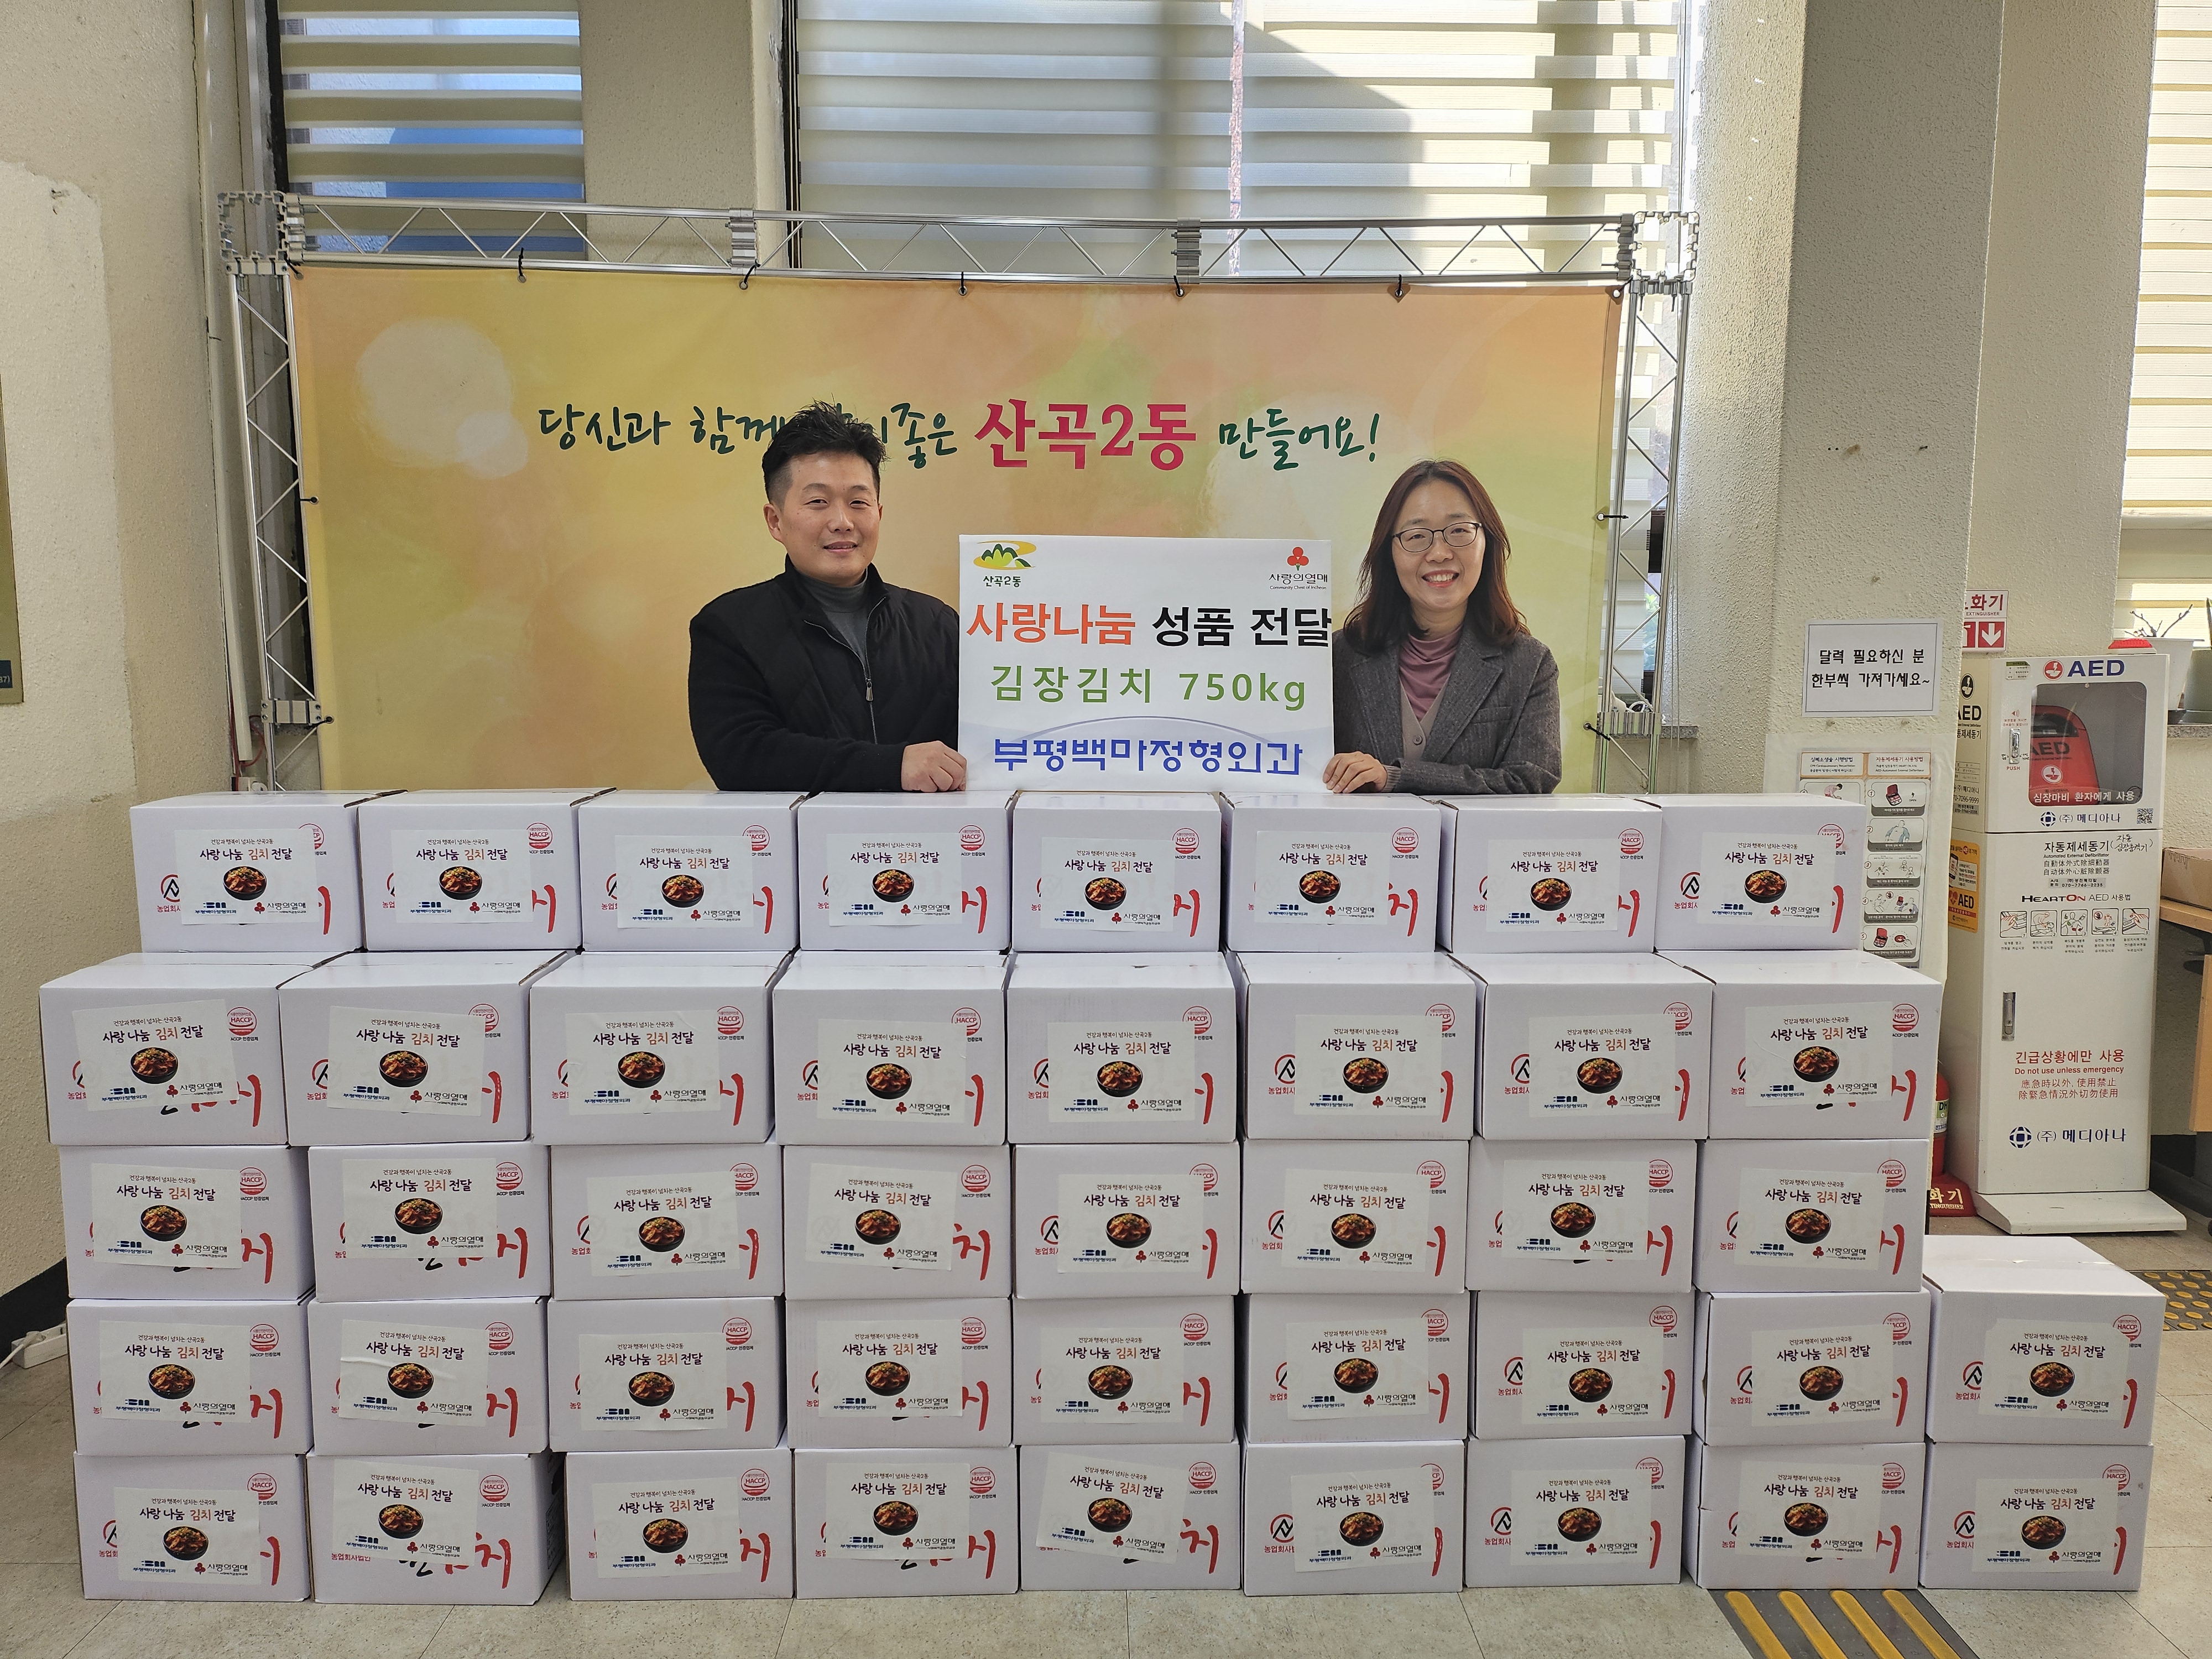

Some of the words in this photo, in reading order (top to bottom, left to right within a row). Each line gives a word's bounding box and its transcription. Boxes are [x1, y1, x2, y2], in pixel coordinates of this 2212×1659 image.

[539, 404, 671, 451] 당신과
[974, 398, 1196, 471] 산곡2동
[1219, 409, 1380, 471] 만들어요!
[983, 575, 1021, 588] 산곡2동
[1269, 573, 1328, 585] 사랑의열매
[1965, 594, 2004, 611] 화기
[967, 603, 1135, 645] 사랑나눔
[1151, 607, 1234, 646] 성품
[1250, 607, 1332, 648] 전달
[1820, 650, 1844, 664] 달력
[1853, 649, 1903, 664] 필요하신
[1913, 649, 1924, 663] 분
[2067, 660, 2125, 677] AED
[1812, 673, 1849, 688] 한부씩
[1859, 672, 1930, 687] 가져가세요~
[991, 665, 1150, 703] 김장김치
[1179, 673, 1305, 711] 750kg
[995, 739, 1303, 775] 부평백마정형외과
[2033, 792, 2069, 803] 심장마비
[2075, 791, 2111, 802] 환자에게
[2116, 791, 2135, 801] 사용
[2059, 814, 2073, 823] (주)
[2077, 813, 2121, 823] 메디아나
[416, 849, 436, 860] 사랑
[439, 849, 460, 860] 나눔
[465, 849, 484, 860] 김치
[487, 849, 508, 860] 전달
[1279, 852, 1299, 864] 사랑
[1302, 853, 1321, 864] 나눔
[1326, 854, 1344, 865] 김치
[1348, 854, 1368, 865] 전달
[1725, 852, 1745, 863] 사랑
[1748, 852, 1767, 864] 나눔
[1773, 853, 1791, 864] 김치
[1794, 854, 1814, 865] 전달
[1958, 894, 1974, 909] AED
[1337, 906, 1374, 915] 사랑의열매
[356, 1029, 380, 1042] 사랑
[383, 1031, 405, 1044] 나눔
[411, 1033, 433, 1045] 김치
[437, 1035, 460, 1047] 전달
[1771, 1029, 1792, 1041] 사랑
[1795, 1028, 1817, 1041] 나눔
[1822, 1027, 1843, 1040] 김치
[1846, 1026, 1868, 1039] 전달
[1074, 1042, 1095, 1055] 사랑
[1098, 1042, 1120, 1055] 나눔
[1125, 1042, 1146, 1055] 김치
[1150, 1042, 1171, 1054] 전달
[2016, 1051, 2092, 1064] 긴급상황에만
[2099, 1049, 2125, 1062] 사용
[1141, 1099, 1181, 1108] 사랑의열매
[2037, 1131, 2057, 1142] (주)
[2062, 1128, 2126, 1142] 메디아나
[117, 1185, 139, 1197] 사랑
[142, 1186, 163, 1198] 나눔
[169, 1187, 190, 1199] 김치
[194, 1188, 216, 1201] 전달
[1084, 1194, 1105, 1207] 사랑
[1108, 1194, 1130, 1207] 나눔
[1135, 1195, 1155, 1207] 김치
[1159, 1195, 1180, 1207] 전달
[842, 1344, 864, 1355] 사랑
[867, 1344, 888, 1355] 나눔
[893, 1343, 913, 1355] 김치
[917, 1343, 938, 1355] 전달
[2010, 1342, 2032, 1355] 사랑
[2034, 1344, 2055, 1356] 나눔
[2061, 1345, 2080, 1357] 김치
[2084, 1346, 2105, 1358] 전달
[618, 1502, 640, 1514] 사랑
[643, 1501, 664, 1513] 나눔
[669, 1499, 690, 1512] 김치
[693, 1498, 714, 1511] 전달
[2001, 1498, 2022, 1510] 사랑
[2025, 1498, 2046, 1510] 나눔
[2051, 1498, 2071, 1510] 김치
[2074, 1498, 2095, 1510] 전달
